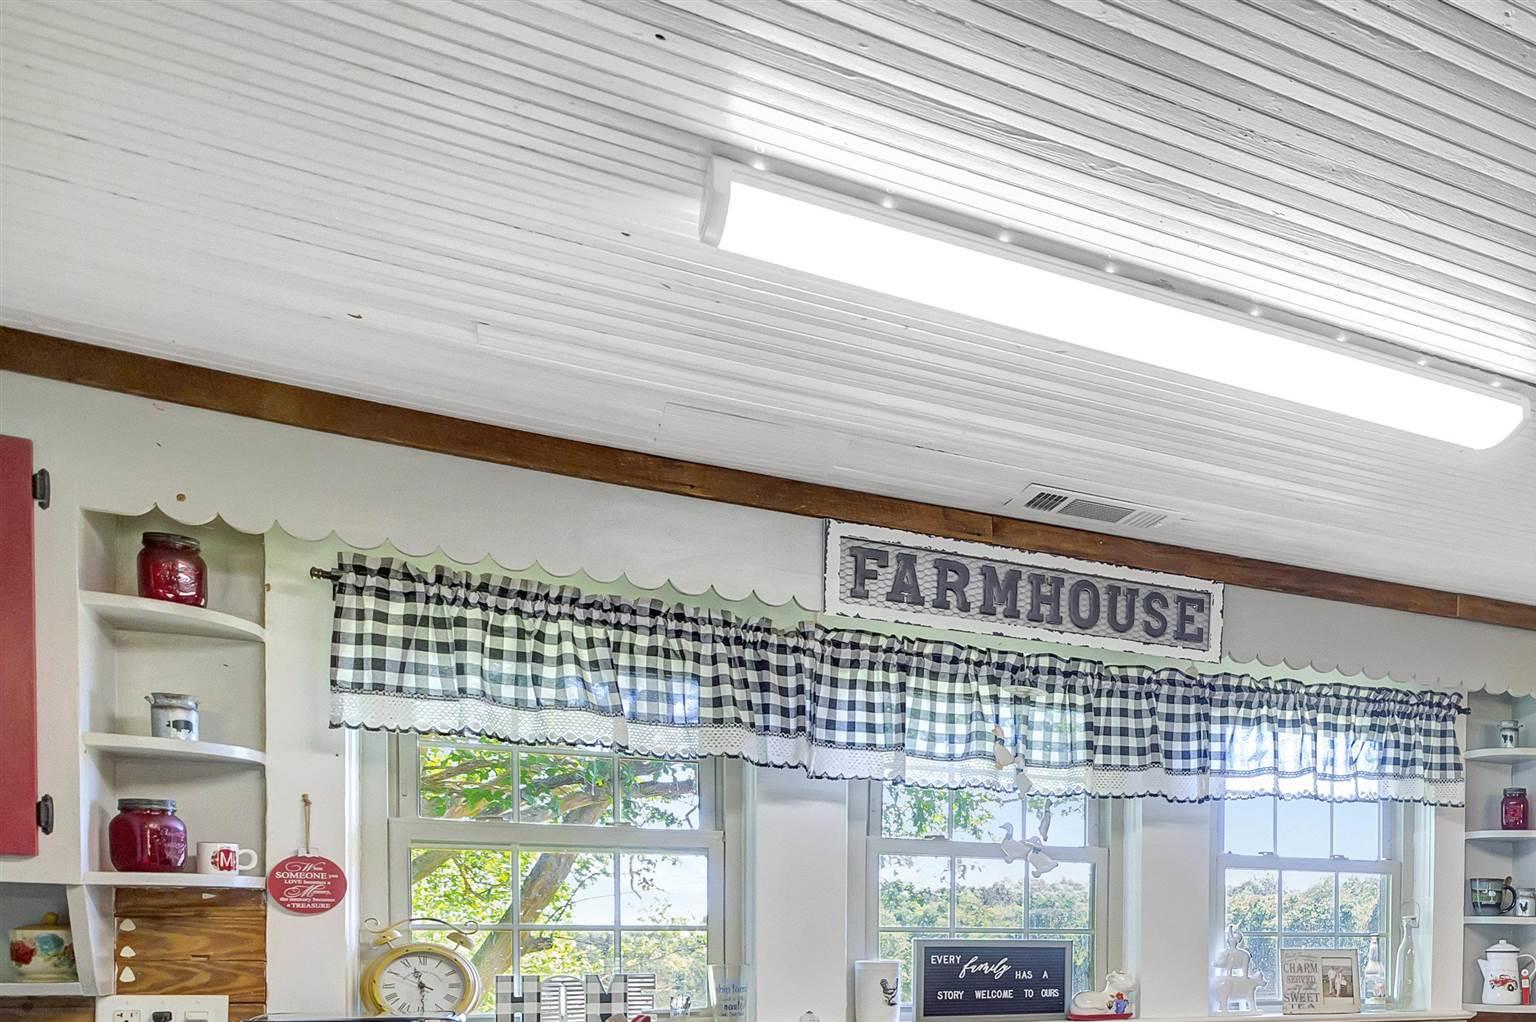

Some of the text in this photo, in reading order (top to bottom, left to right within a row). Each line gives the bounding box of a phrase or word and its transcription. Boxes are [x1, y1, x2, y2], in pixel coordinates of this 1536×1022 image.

[849, 546, 1205, 643] FARMHOUSE
[219, 851, 234, 867] M
[930, 955, 1049, 980] EVERY family HAS A
[1284, 963, 1318, 974] CHARM
[1286, 975, 1316, 984] SERVED
[937, 988, 1060, 1000] STORY WELCOME TO OURS
[1284, 992, 1320, 1003] SWEET
